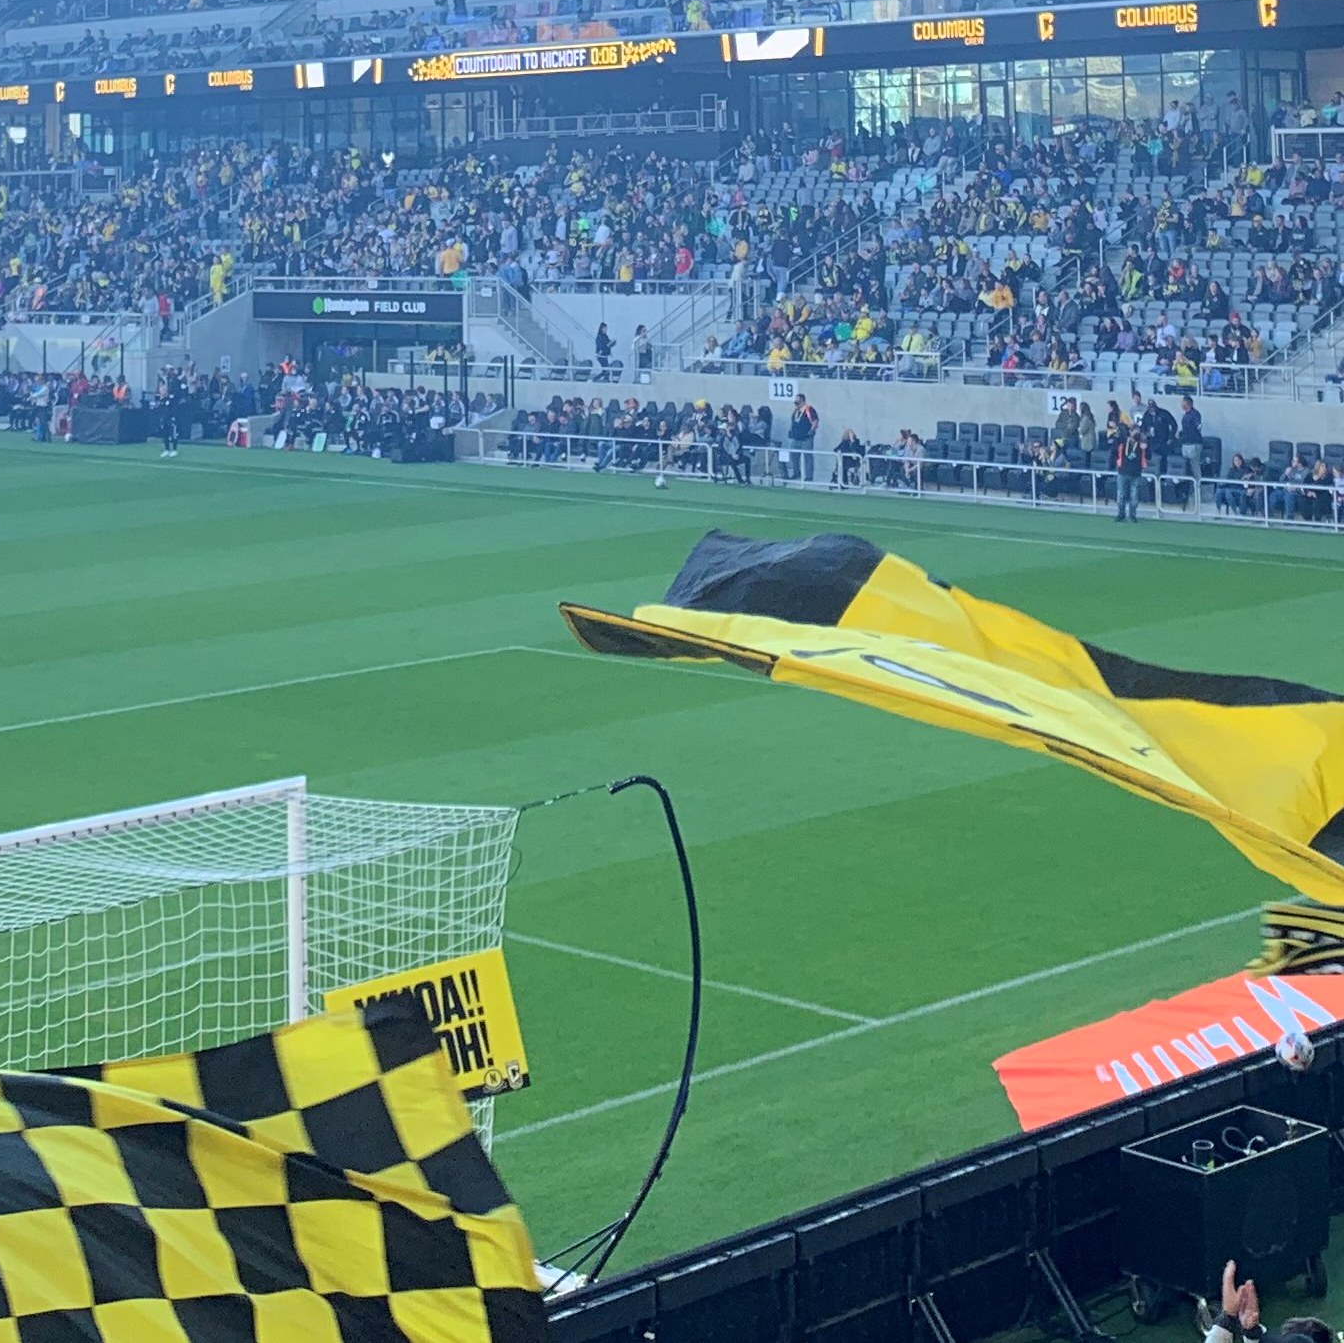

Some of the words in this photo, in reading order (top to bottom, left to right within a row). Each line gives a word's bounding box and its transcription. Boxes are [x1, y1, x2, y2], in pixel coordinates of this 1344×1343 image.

[1116, 4, 1198, 28] COLUMBUS
[913, 18, 985, 41] COLUMBUS
[1175, 23, 1198, 34] CREW
[456, 54, 521, 75] COUNTDOWN
[523, 53, 539, 70] TO
[541, 48, 587, 70] KICKOFF
[590, 45, 618, 65] 0:06
[95, 77, 137, 95] COLUMBUS
[208, 69, 253, 87] COLUMBUS
[374, 301, 400, 313] FIELD
[402, 301, 427, 313] CLUB
[773, 383, 794, 398] 119
